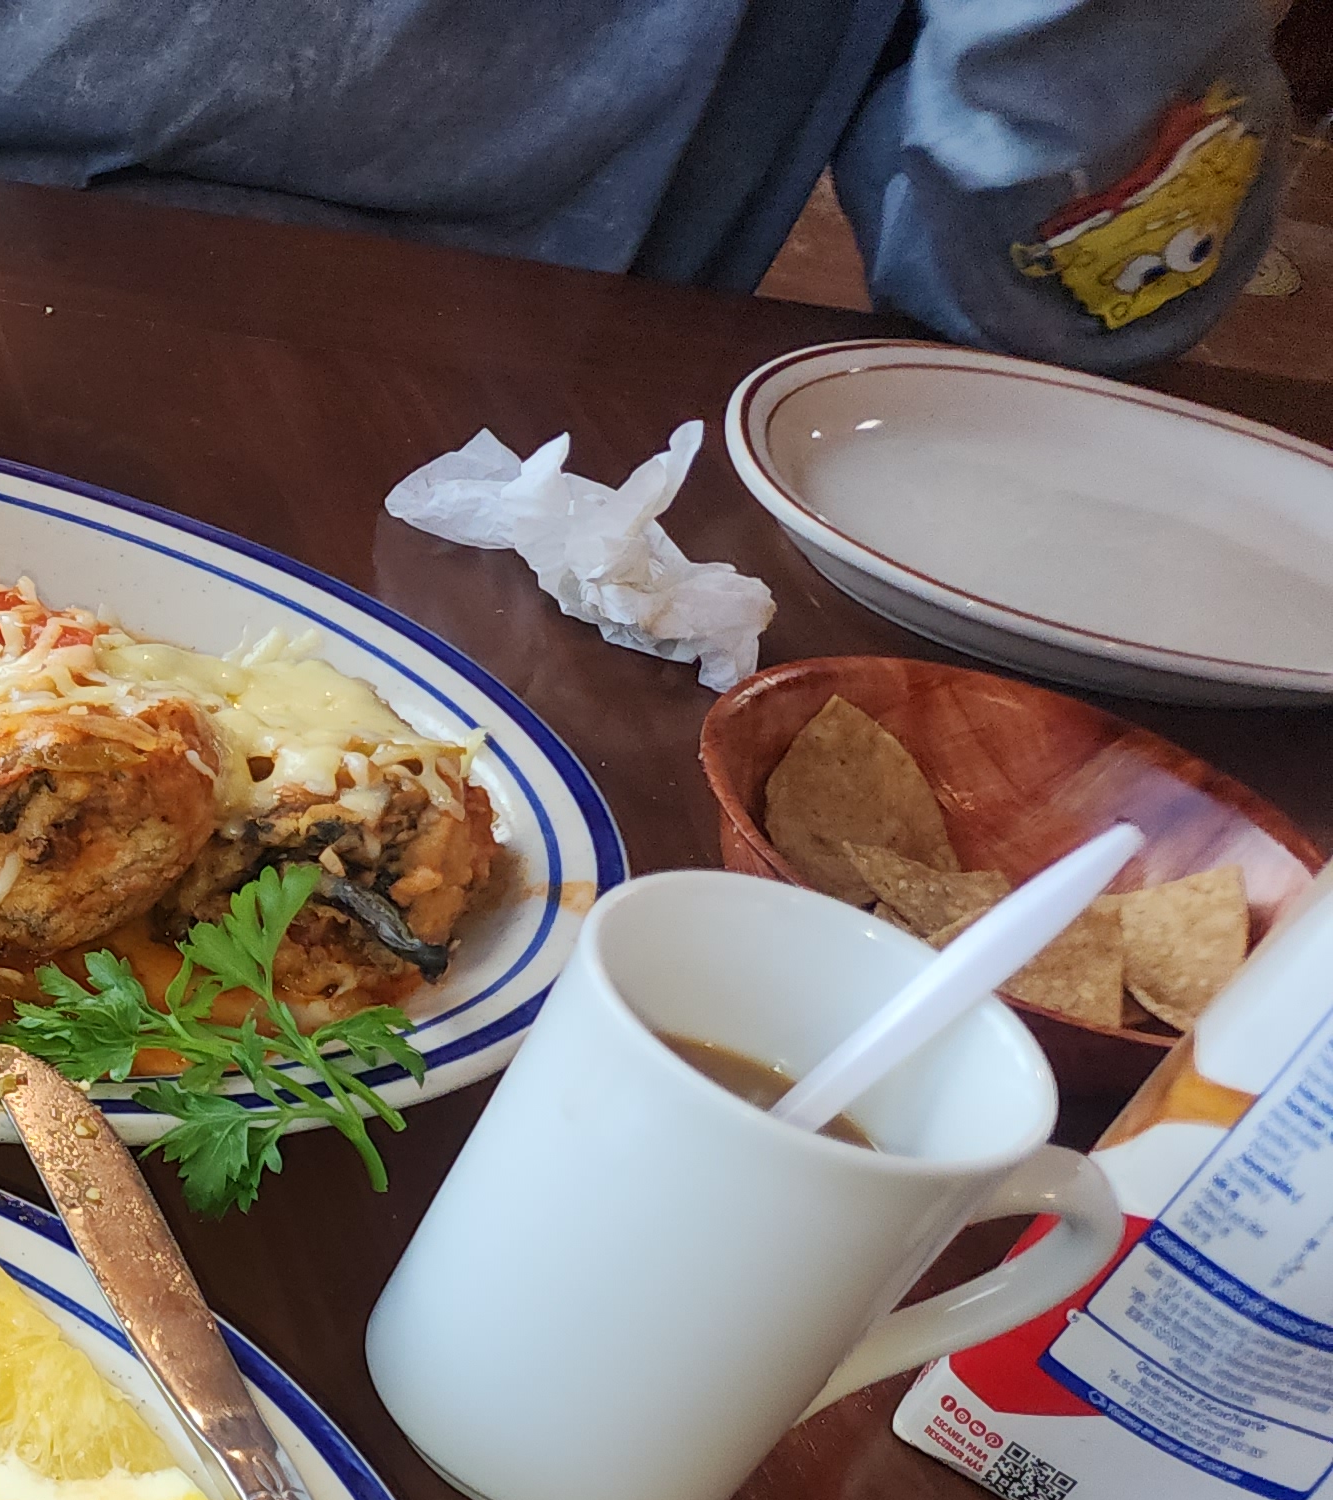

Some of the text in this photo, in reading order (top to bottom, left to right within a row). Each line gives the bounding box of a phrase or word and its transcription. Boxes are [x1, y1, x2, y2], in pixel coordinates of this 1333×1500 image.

[924, 1425, 965, 1460] DESCUBRIR
[932, 1415, 988, 1462] ESCANEA PARA
